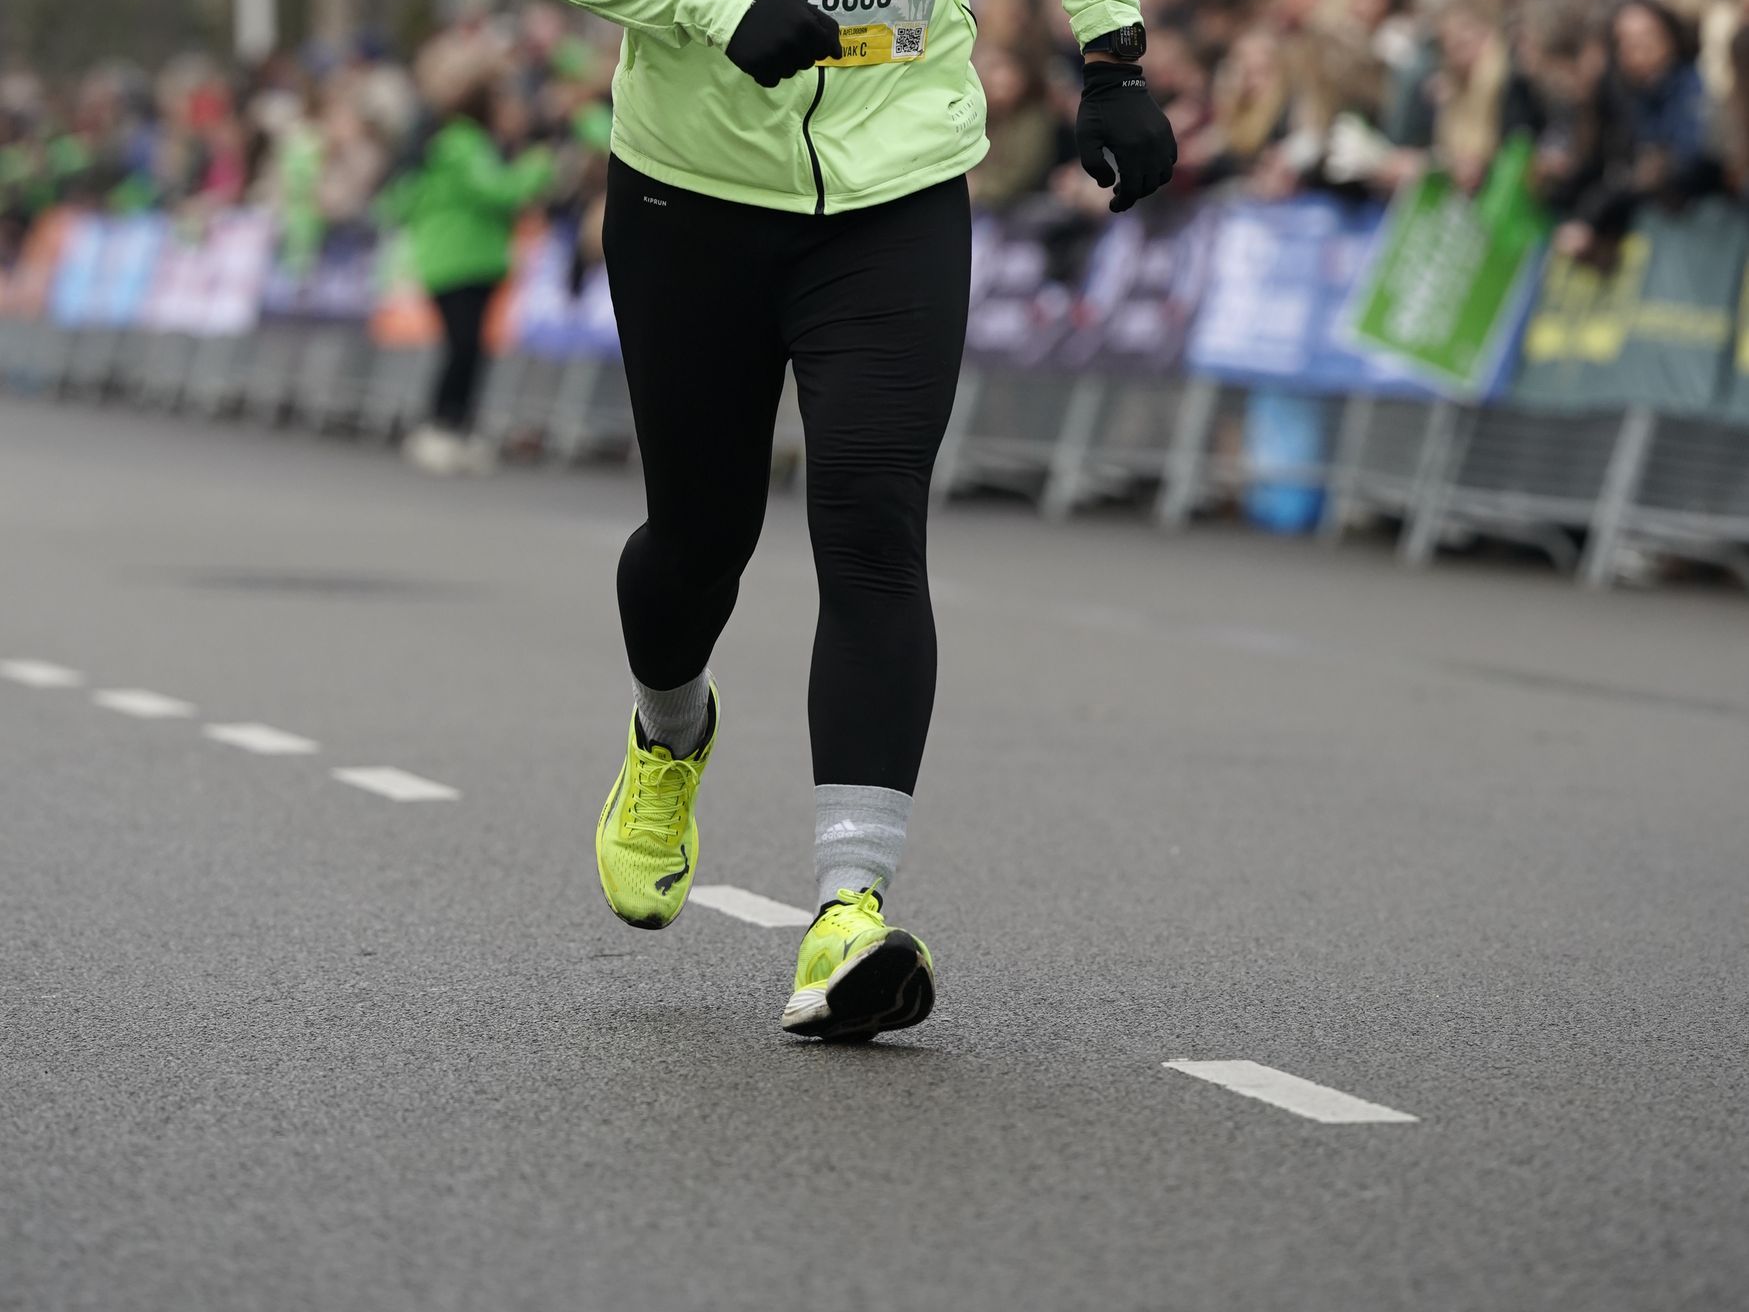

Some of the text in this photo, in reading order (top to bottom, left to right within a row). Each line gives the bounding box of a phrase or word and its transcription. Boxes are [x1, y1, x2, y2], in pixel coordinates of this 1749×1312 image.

[843, 27, 868, 36] APELDOORN
[860, 42, 867, 57] C
[643, 196, 667, 206] KIPRUN
